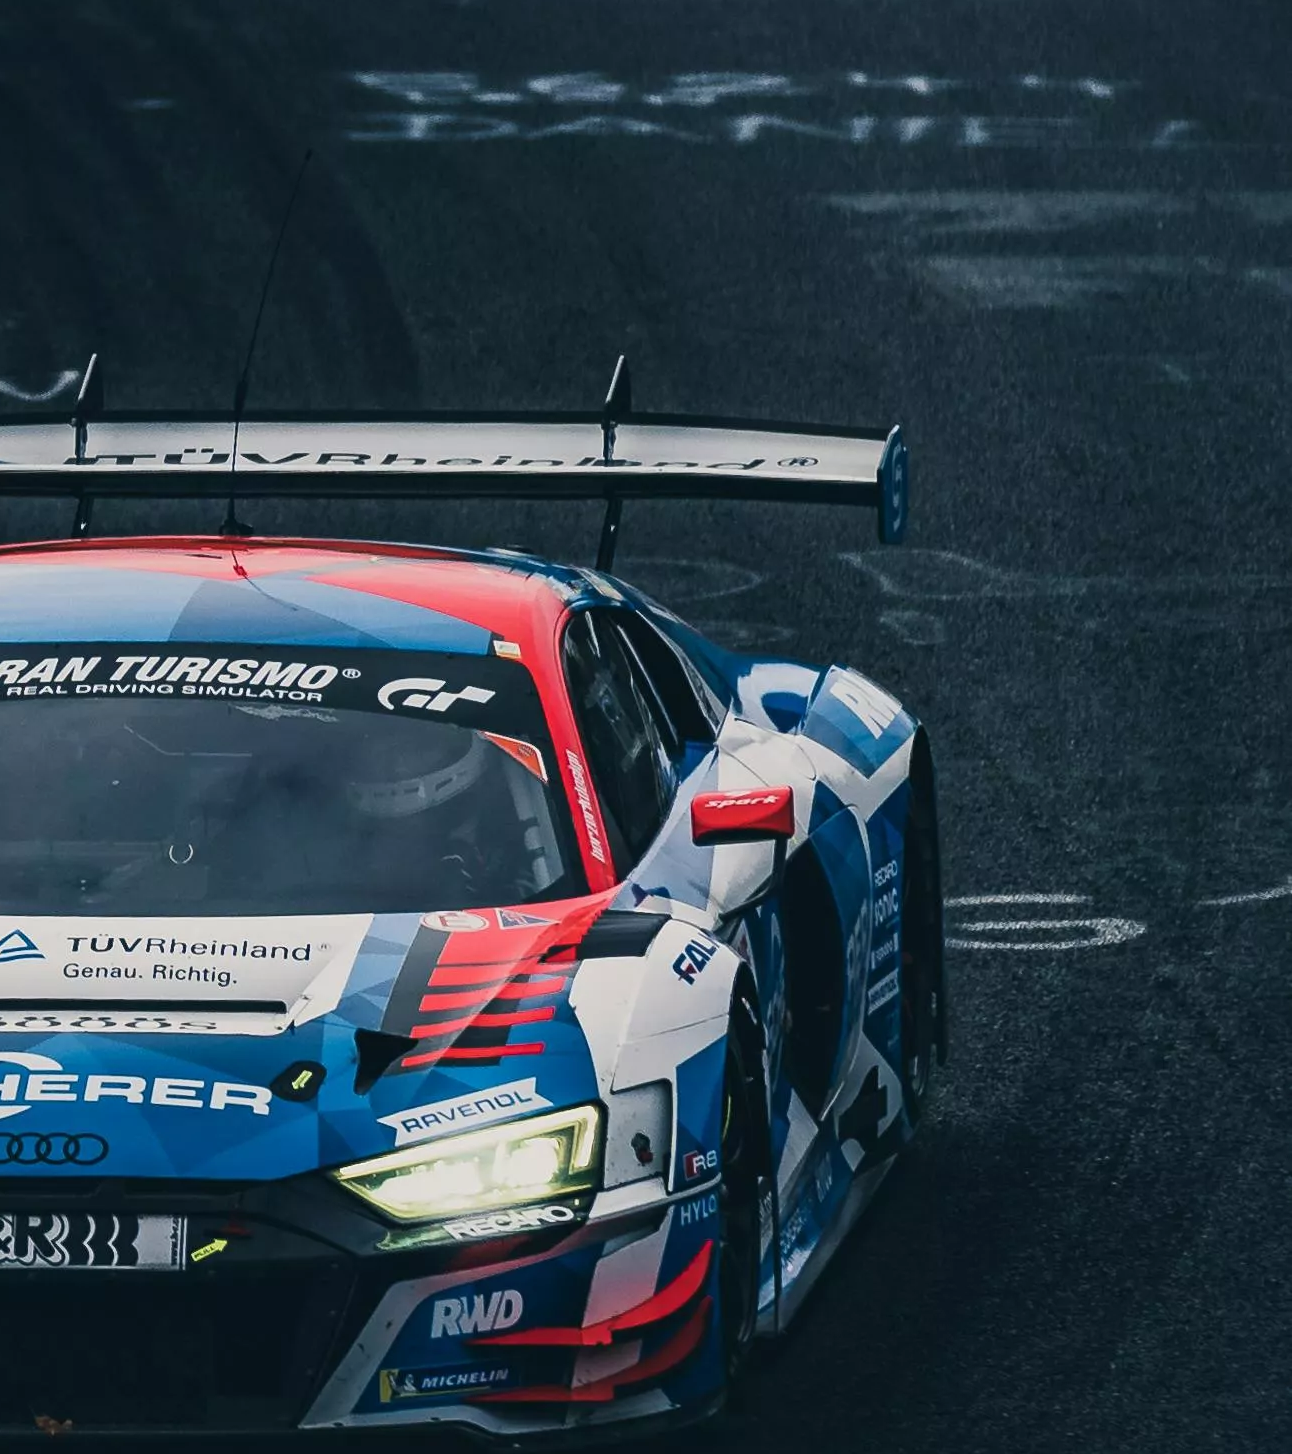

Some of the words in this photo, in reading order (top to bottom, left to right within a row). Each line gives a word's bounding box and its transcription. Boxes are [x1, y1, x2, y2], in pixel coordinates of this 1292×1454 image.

[115, 655, 339, 690] TURISMO
[6, 685, 68, 698] REAL
[75, 683, 174, 695] DRIVING
[181, 685, 324, 702] SIMULATOR
[704, 794, 781, 809] spark
[66, 933, 312, 961] TÜVRheinland
[62, 963, 143, 979] Genau.
[152, 965, 238, 987] Richtig.
[399, 1089, 534, 1133] RAVENOL
[442, 1205, 575, 1241] RECARO
[430, 1289, 524, 1339] RWD
[421, 1368, 510, 1390] MICHELIN
